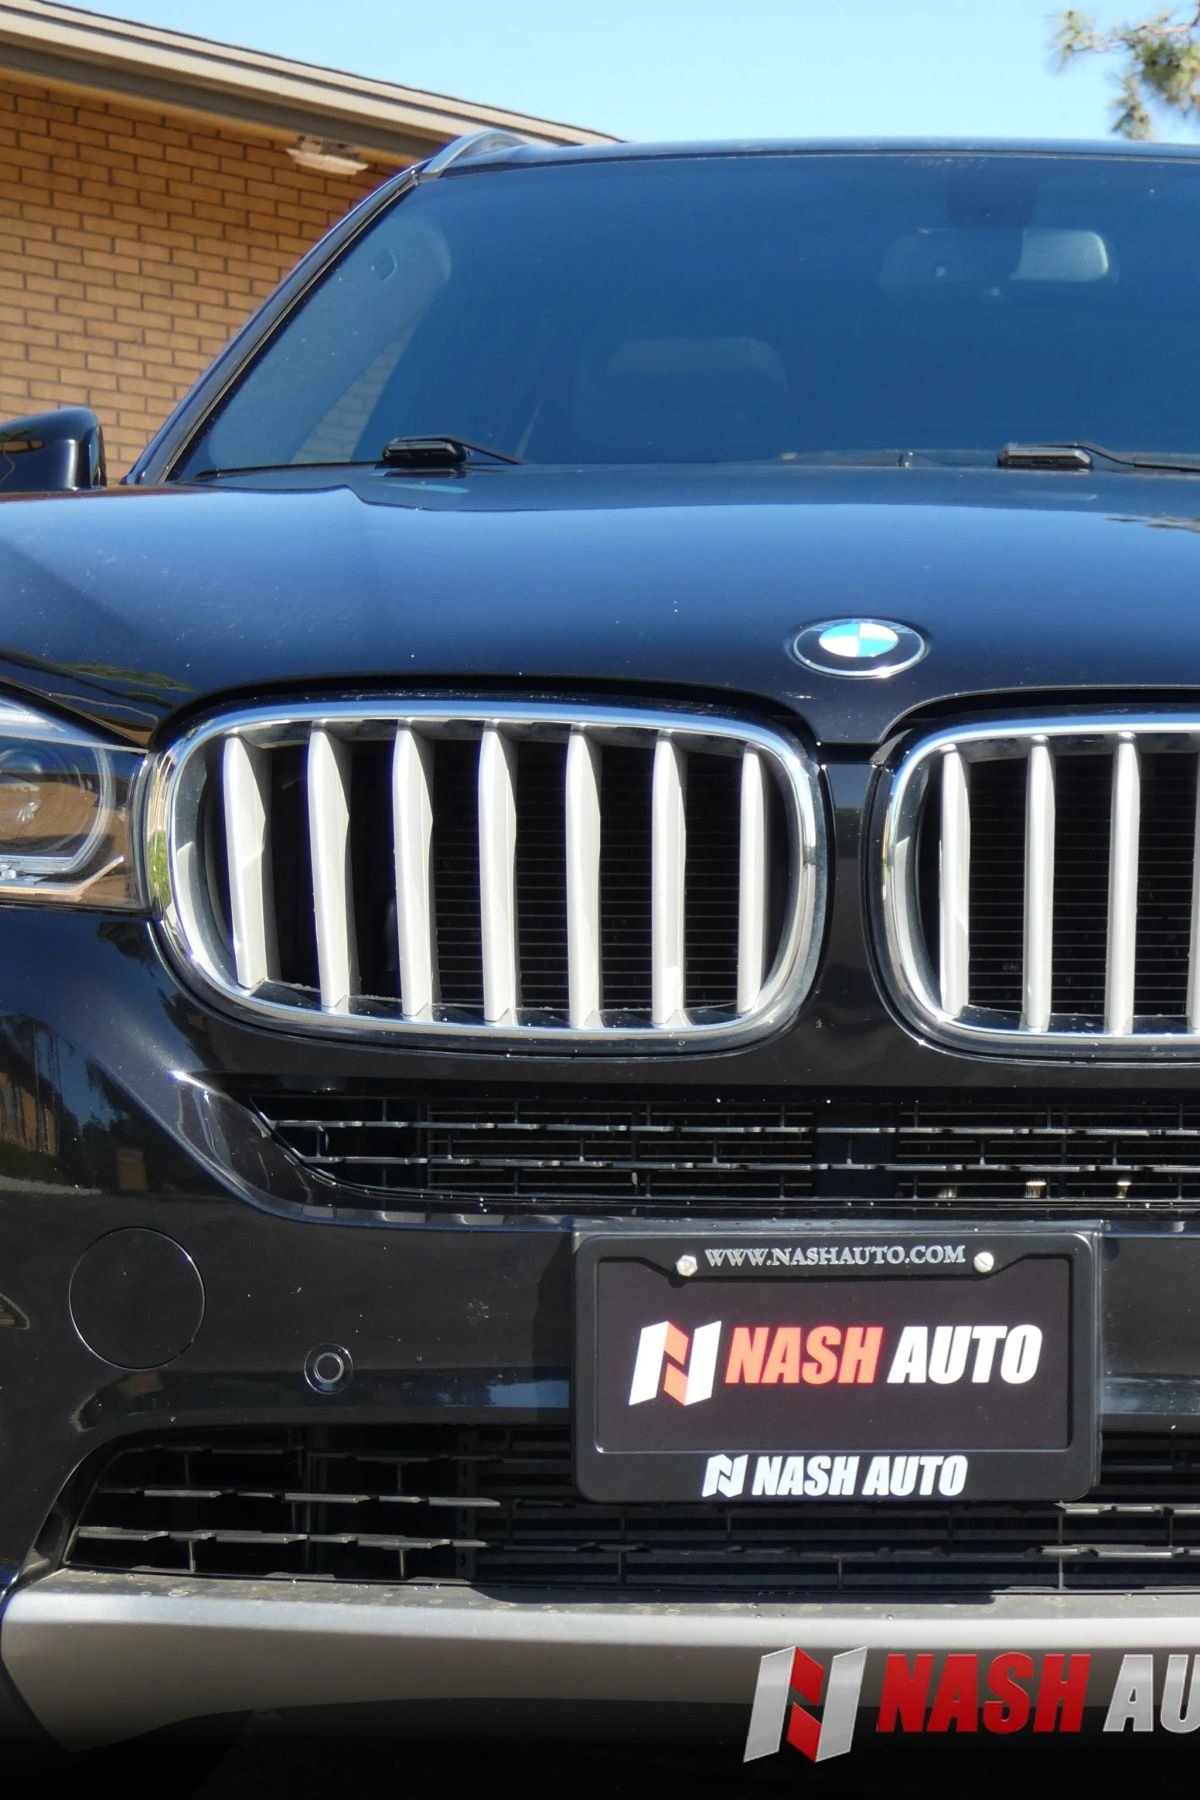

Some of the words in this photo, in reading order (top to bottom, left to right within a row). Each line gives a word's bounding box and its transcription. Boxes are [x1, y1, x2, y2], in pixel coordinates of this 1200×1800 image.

[704, 1245, 966, 1268] WWW.NASHAUTO.COM
[724, 1326, 885, 1384] NASH
[887, 1324, 1043, 1384] AUTO
[752, 1456, 859, 1496] NASH
[862, 1455, 968, 1496] AUTO
